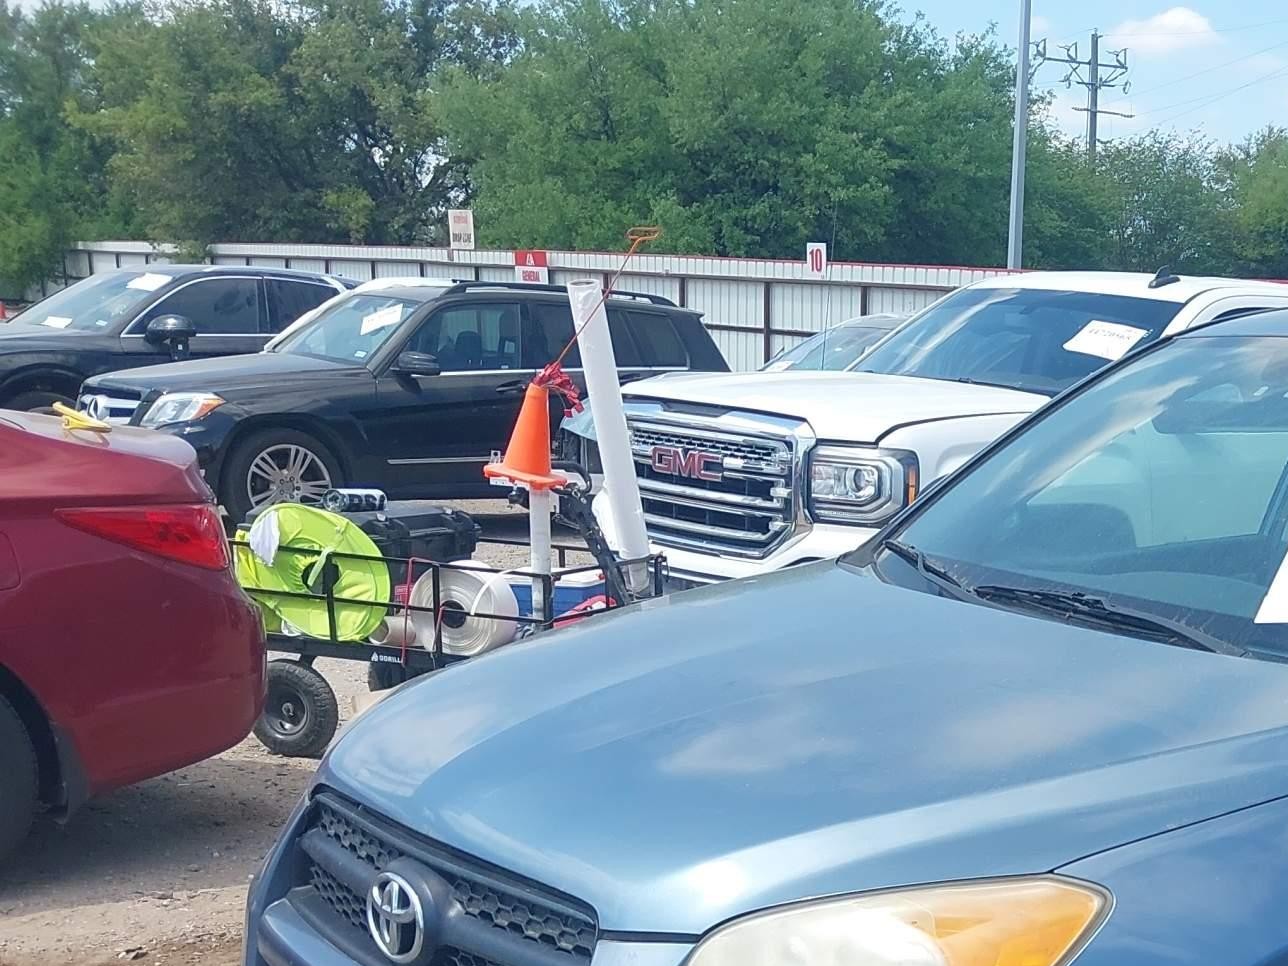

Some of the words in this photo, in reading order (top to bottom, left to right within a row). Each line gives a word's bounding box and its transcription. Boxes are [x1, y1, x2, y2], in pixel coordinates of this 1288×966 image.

[809, 248, 823, 272] 10
[651, 446, 722, 481] GMC
[379, 654, 404, 664] GORILL
